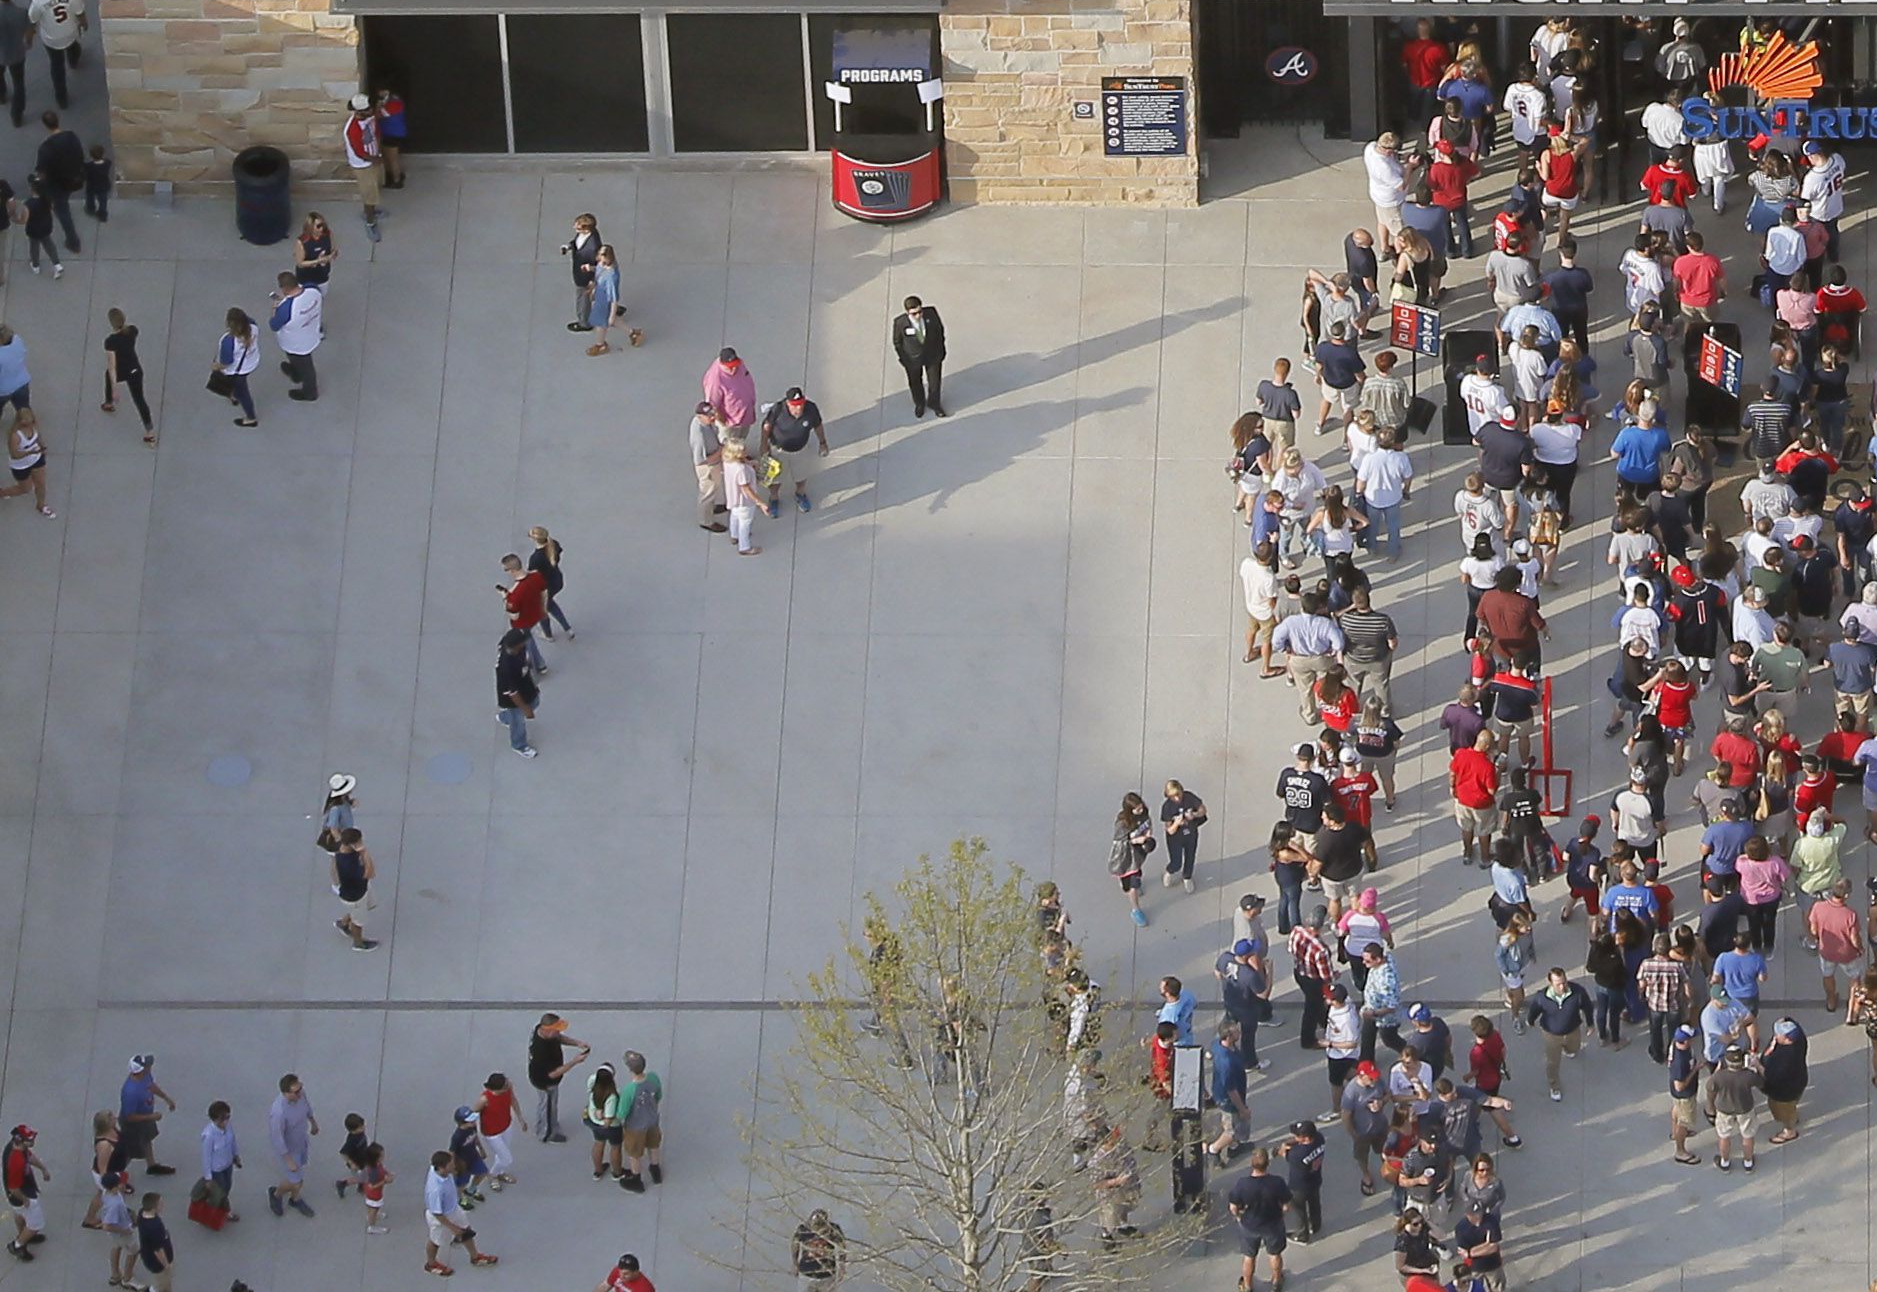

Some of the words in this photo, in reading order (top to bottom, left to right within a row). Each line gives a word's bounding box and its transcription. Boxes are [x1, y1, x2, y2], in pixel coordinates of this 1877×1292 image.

[53, 5, 68, 24] 5
[840, 68, 923, 84] PROGRAMS
[1467, 393, 1485, 415] 10
[1285, 786, 1312, 809] 29
